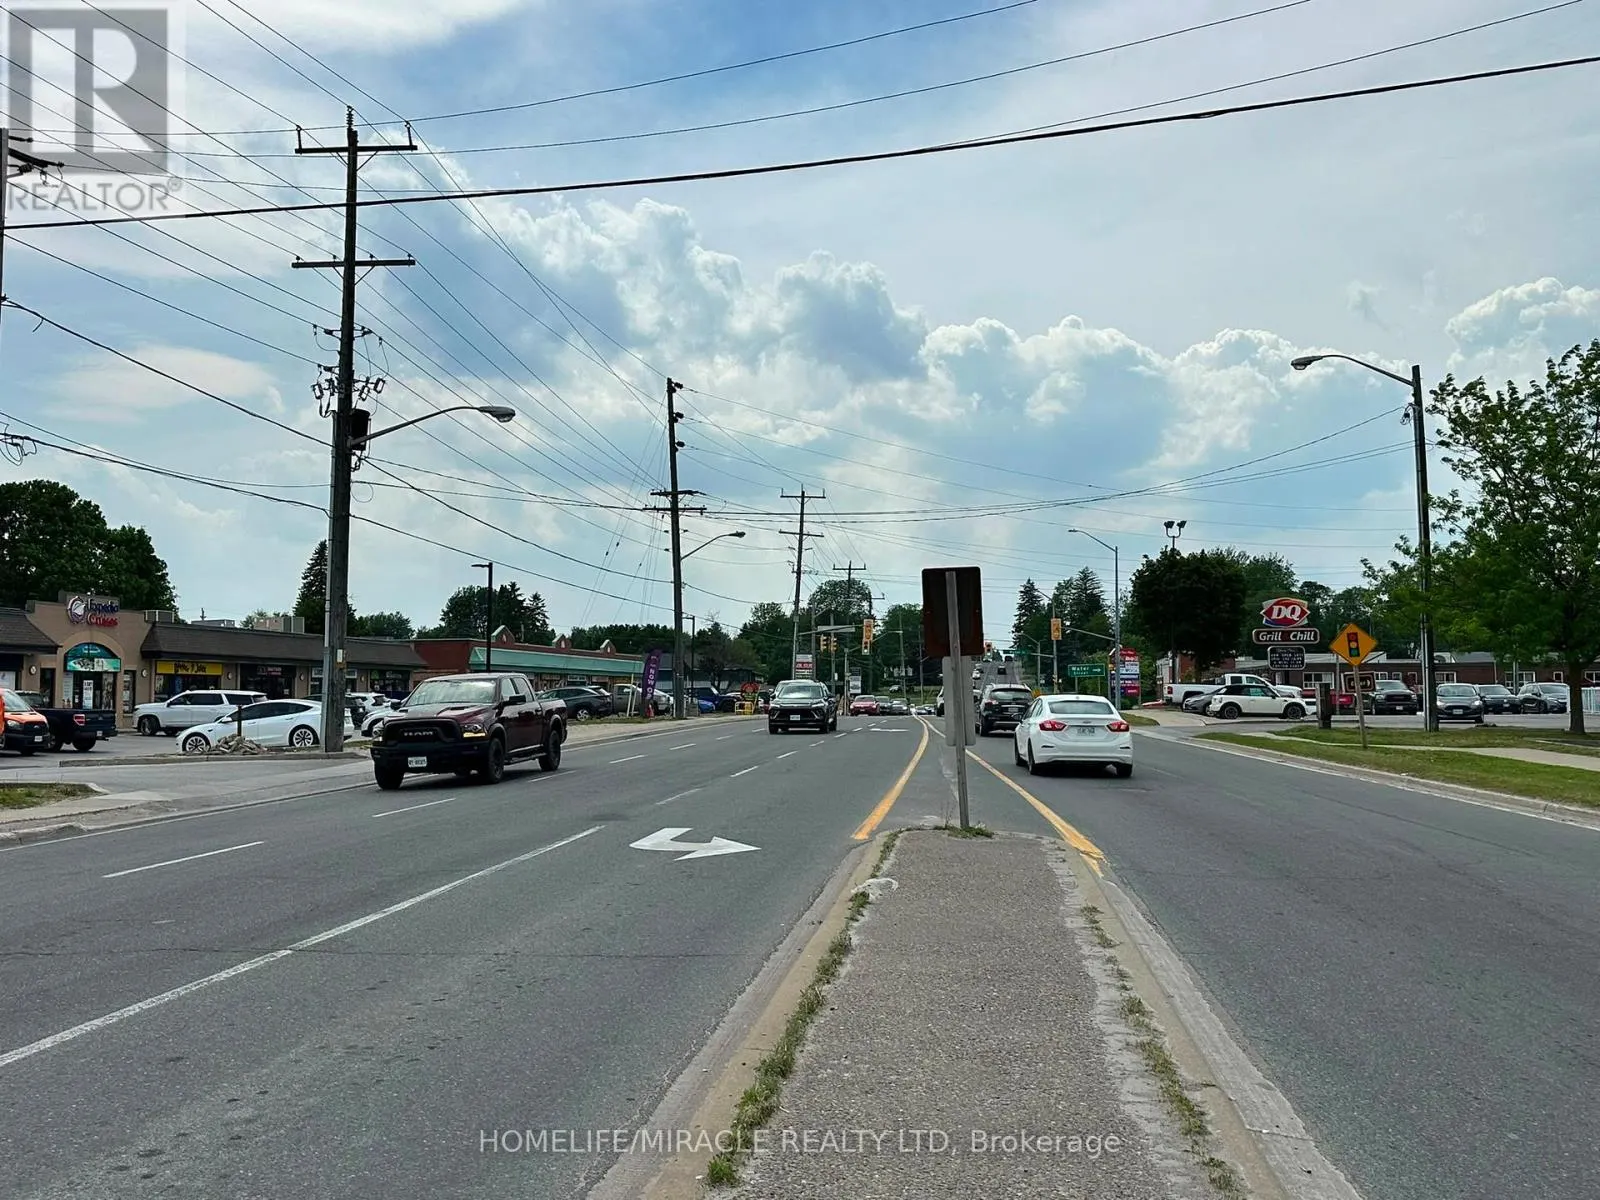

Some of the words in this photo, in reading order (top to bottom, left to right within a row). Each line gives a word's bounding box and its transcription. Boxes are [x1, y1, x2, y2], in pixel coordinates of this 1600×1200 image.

[1270, 604, 1302, 621] DQ
[1259, 631, 1282, 641] Grill
[1289, 631, 1315, 641] Chill
